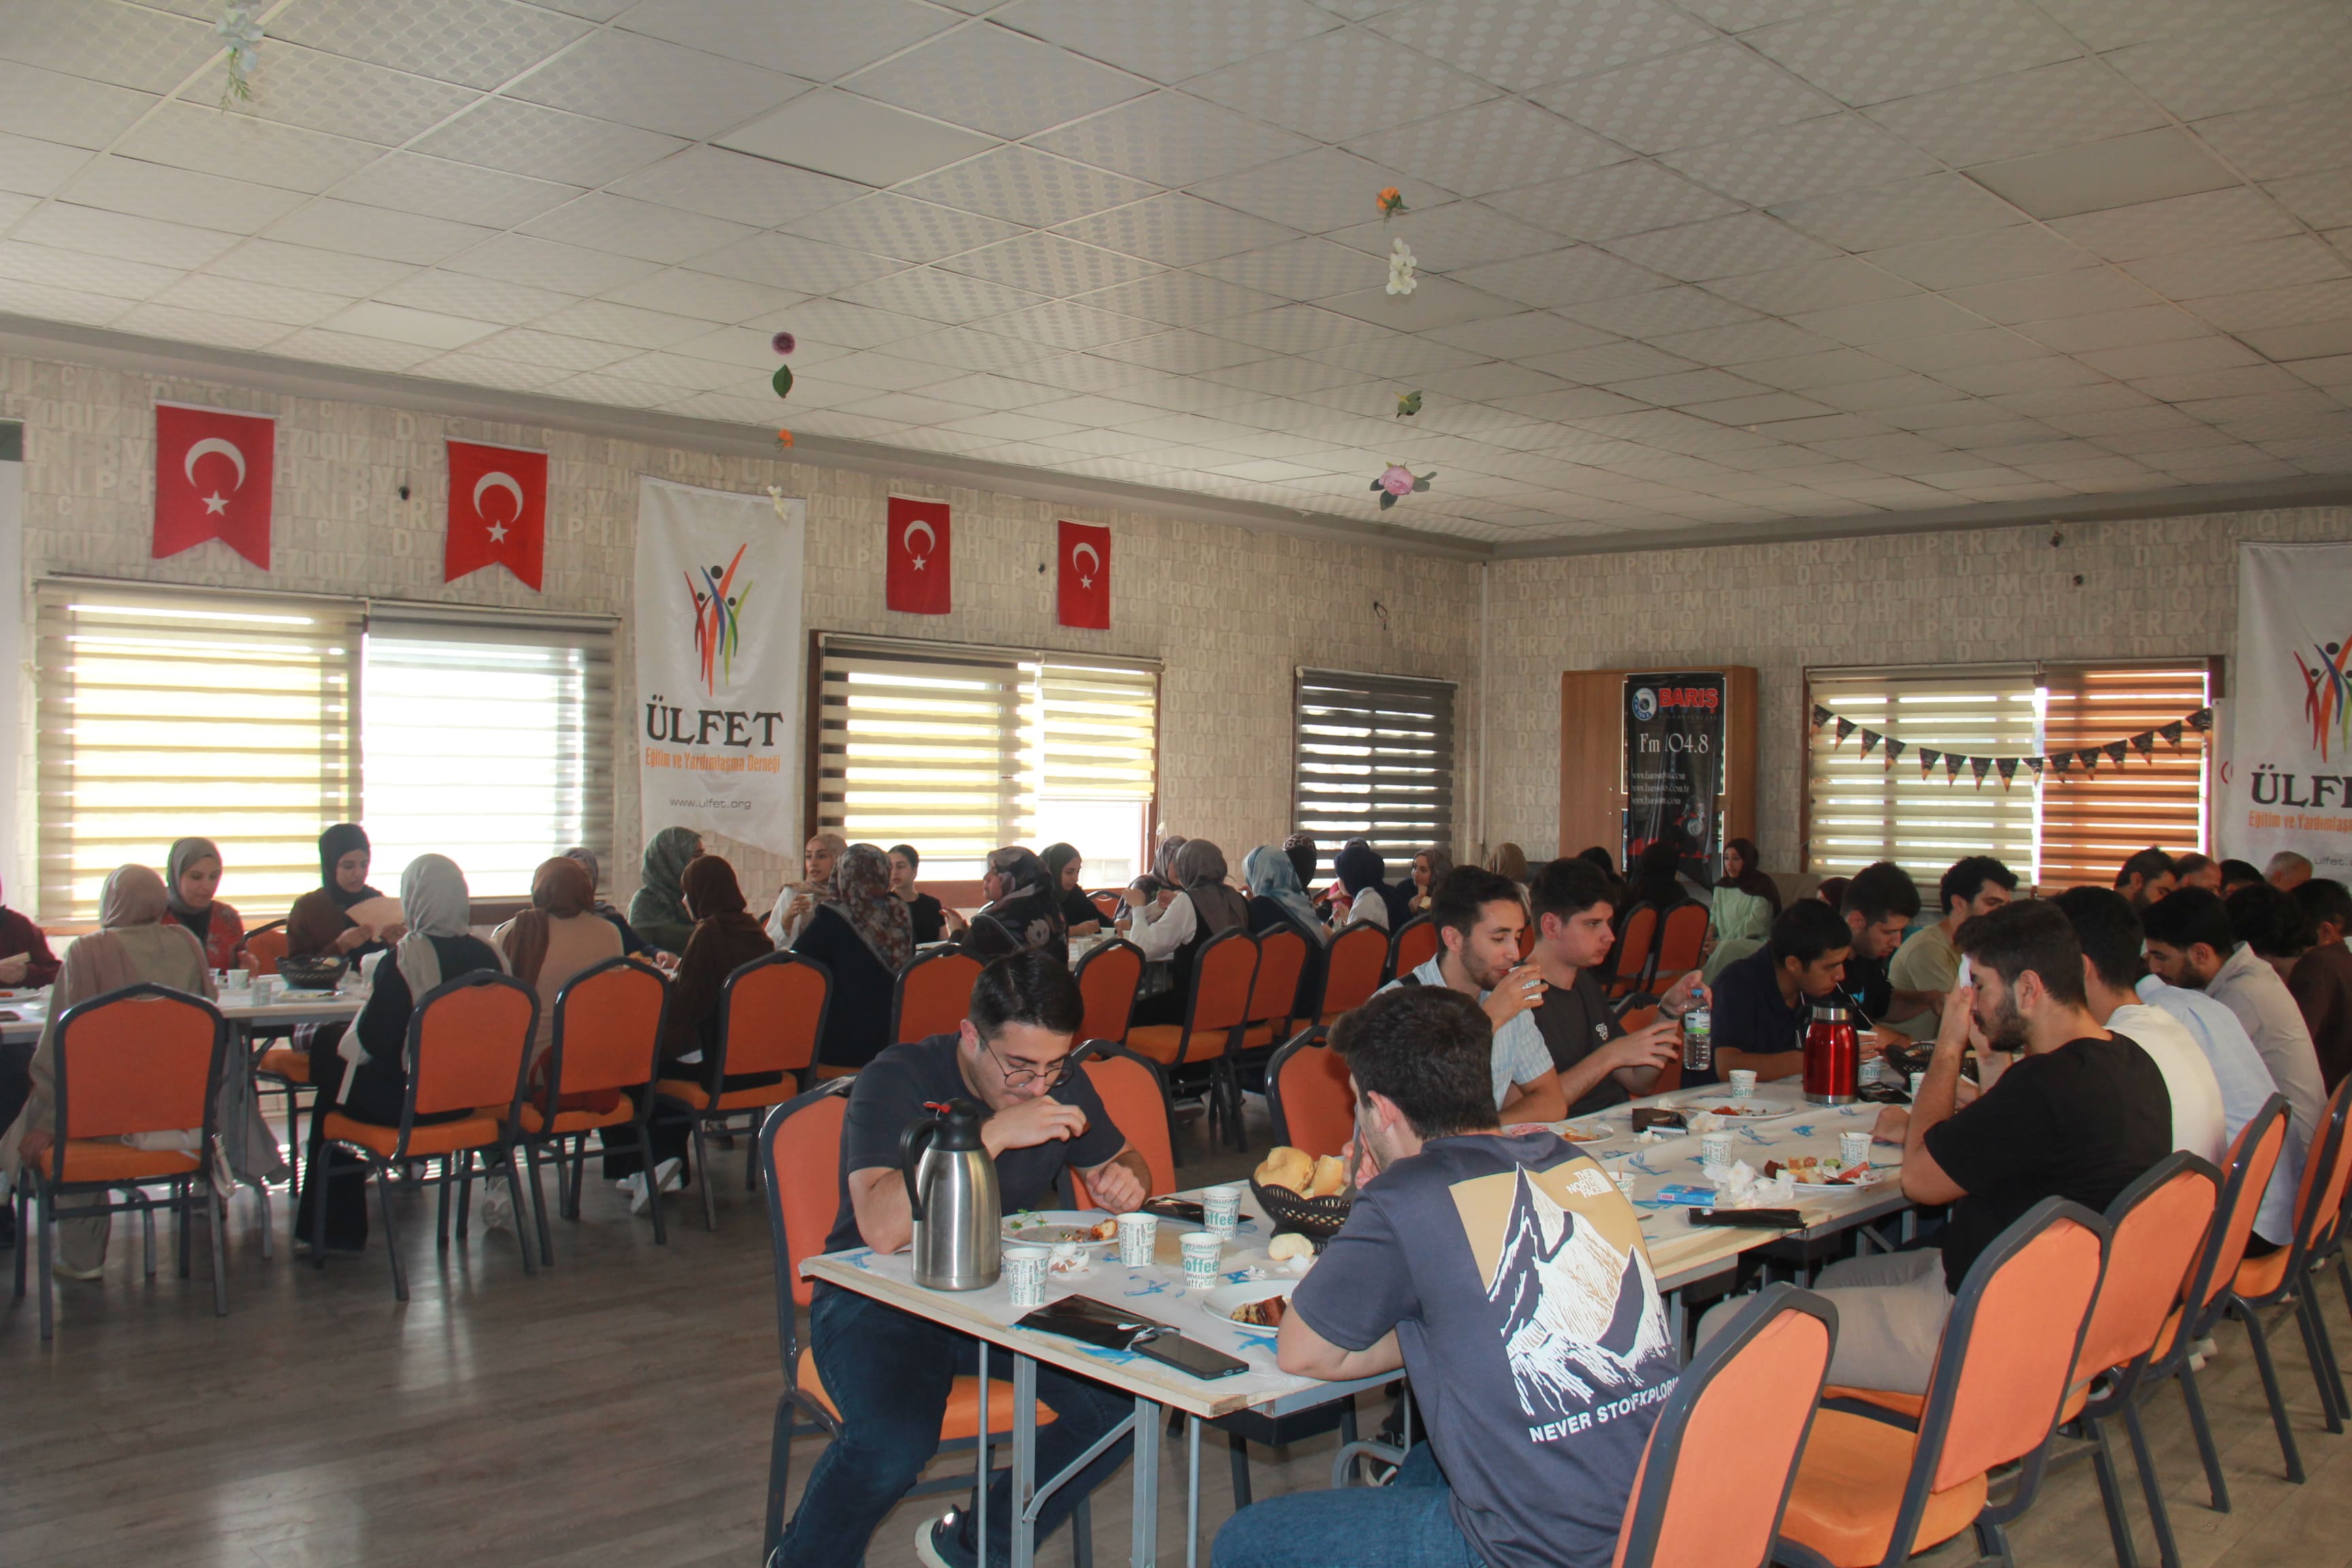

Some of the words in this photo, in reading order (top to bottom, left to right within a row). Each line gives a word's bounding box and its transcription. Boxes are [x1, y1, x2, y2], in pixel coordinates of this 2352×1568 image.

[646, 694, 784, 747] ÜLFET
[1639, 734, 1661, 753] Fm
[1665, 733, 1708, 753] 104.8
[645, 747, 670, 768] Eğitim
[673, 755, 682, 768] ve
[747, 754, 780, 773] Derneği
[670, 798, 751, 810] www.ulfet.org
[2284, 816, 2296, 829] ve
[1529, 1411, 1592, 1443] NEVER
[1597, 1396, 1633, 1423] STO
